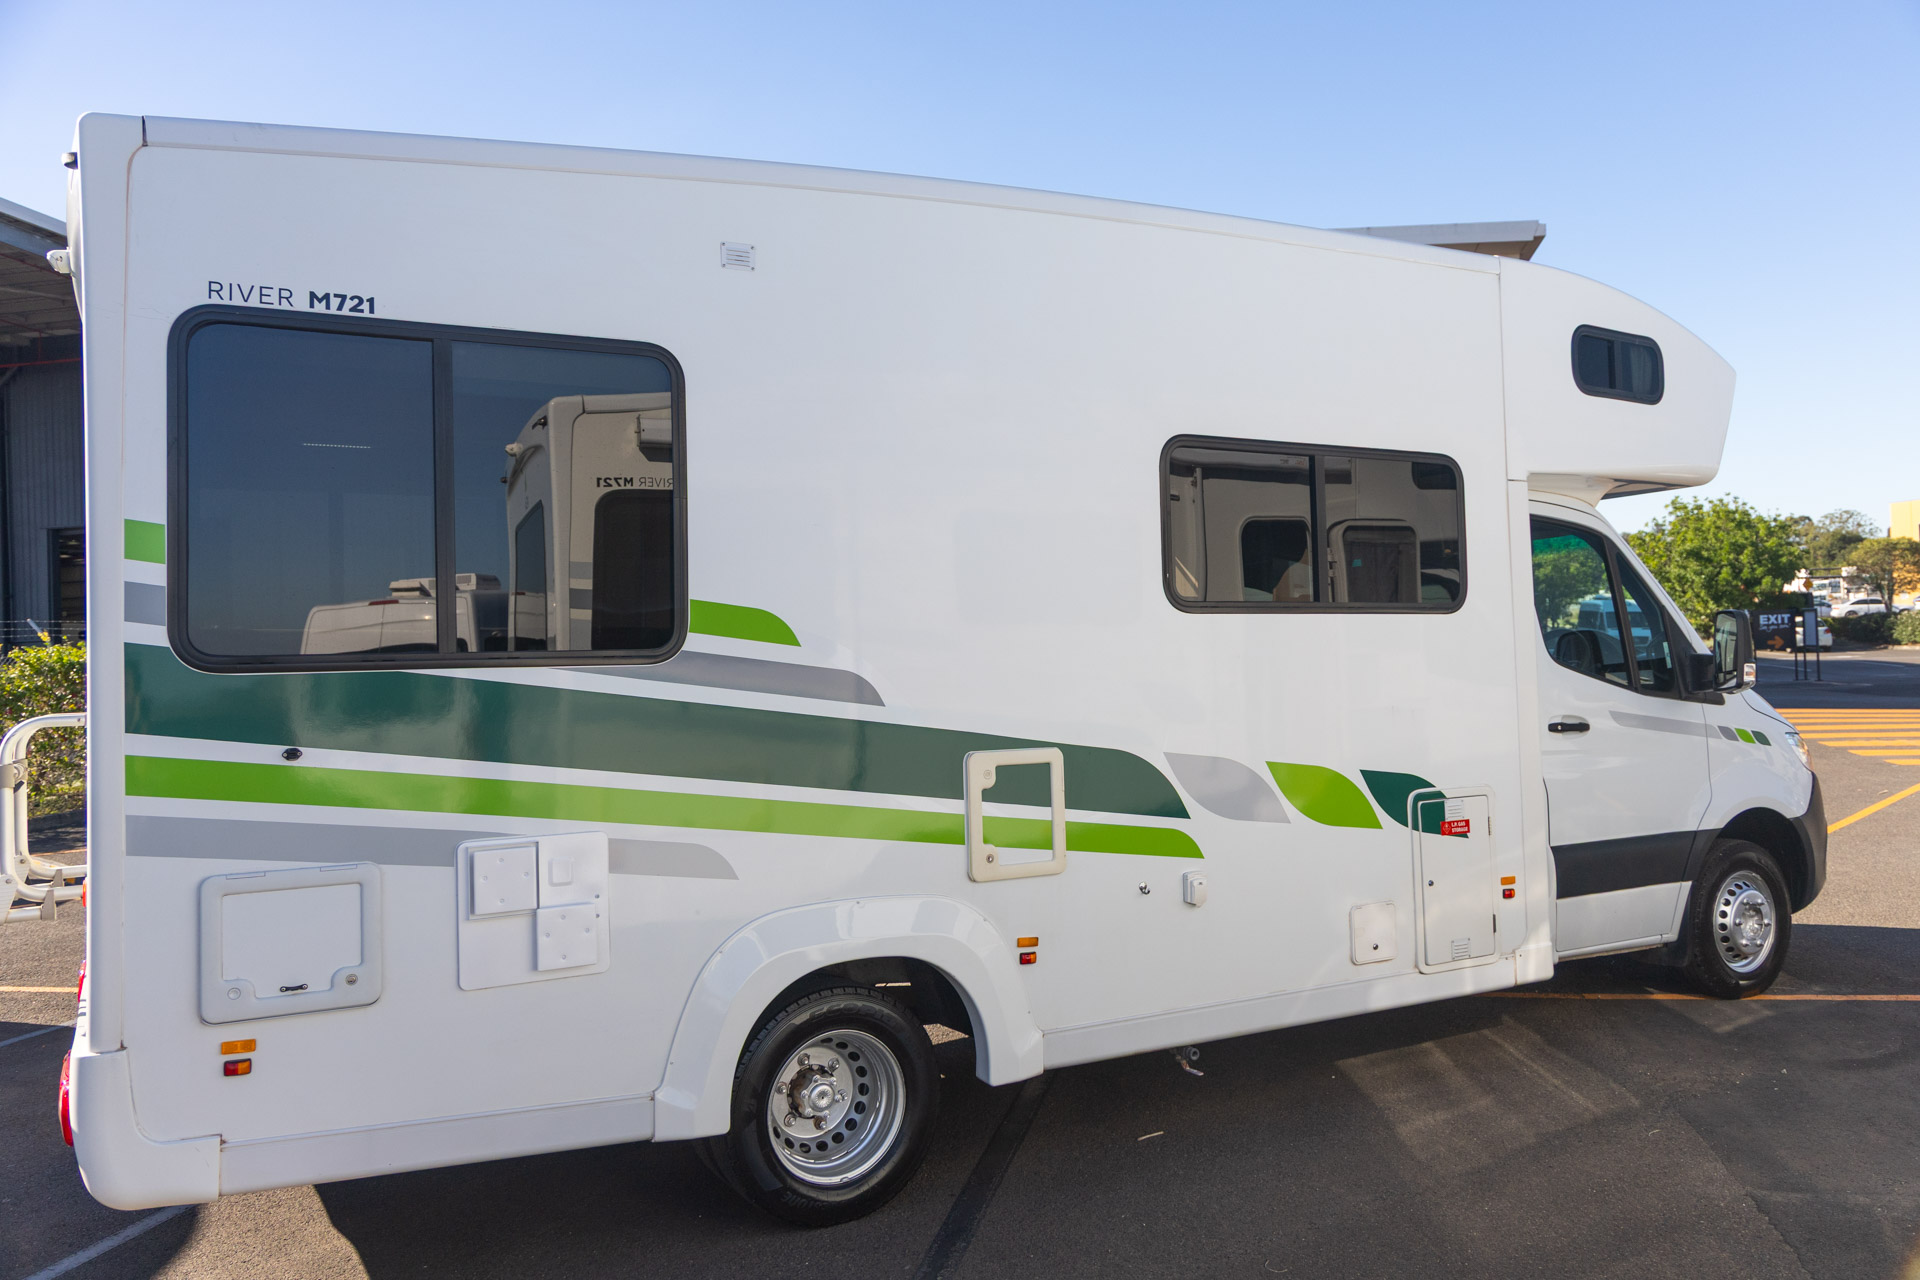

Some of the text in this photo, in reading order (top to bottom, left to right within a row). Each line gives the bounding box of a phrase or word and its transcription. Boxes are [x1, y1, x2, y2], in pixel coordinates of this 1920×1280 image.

[207, 280, 375, 314] RIVER M721
[1759, 614, 1790, 624] EXIT
